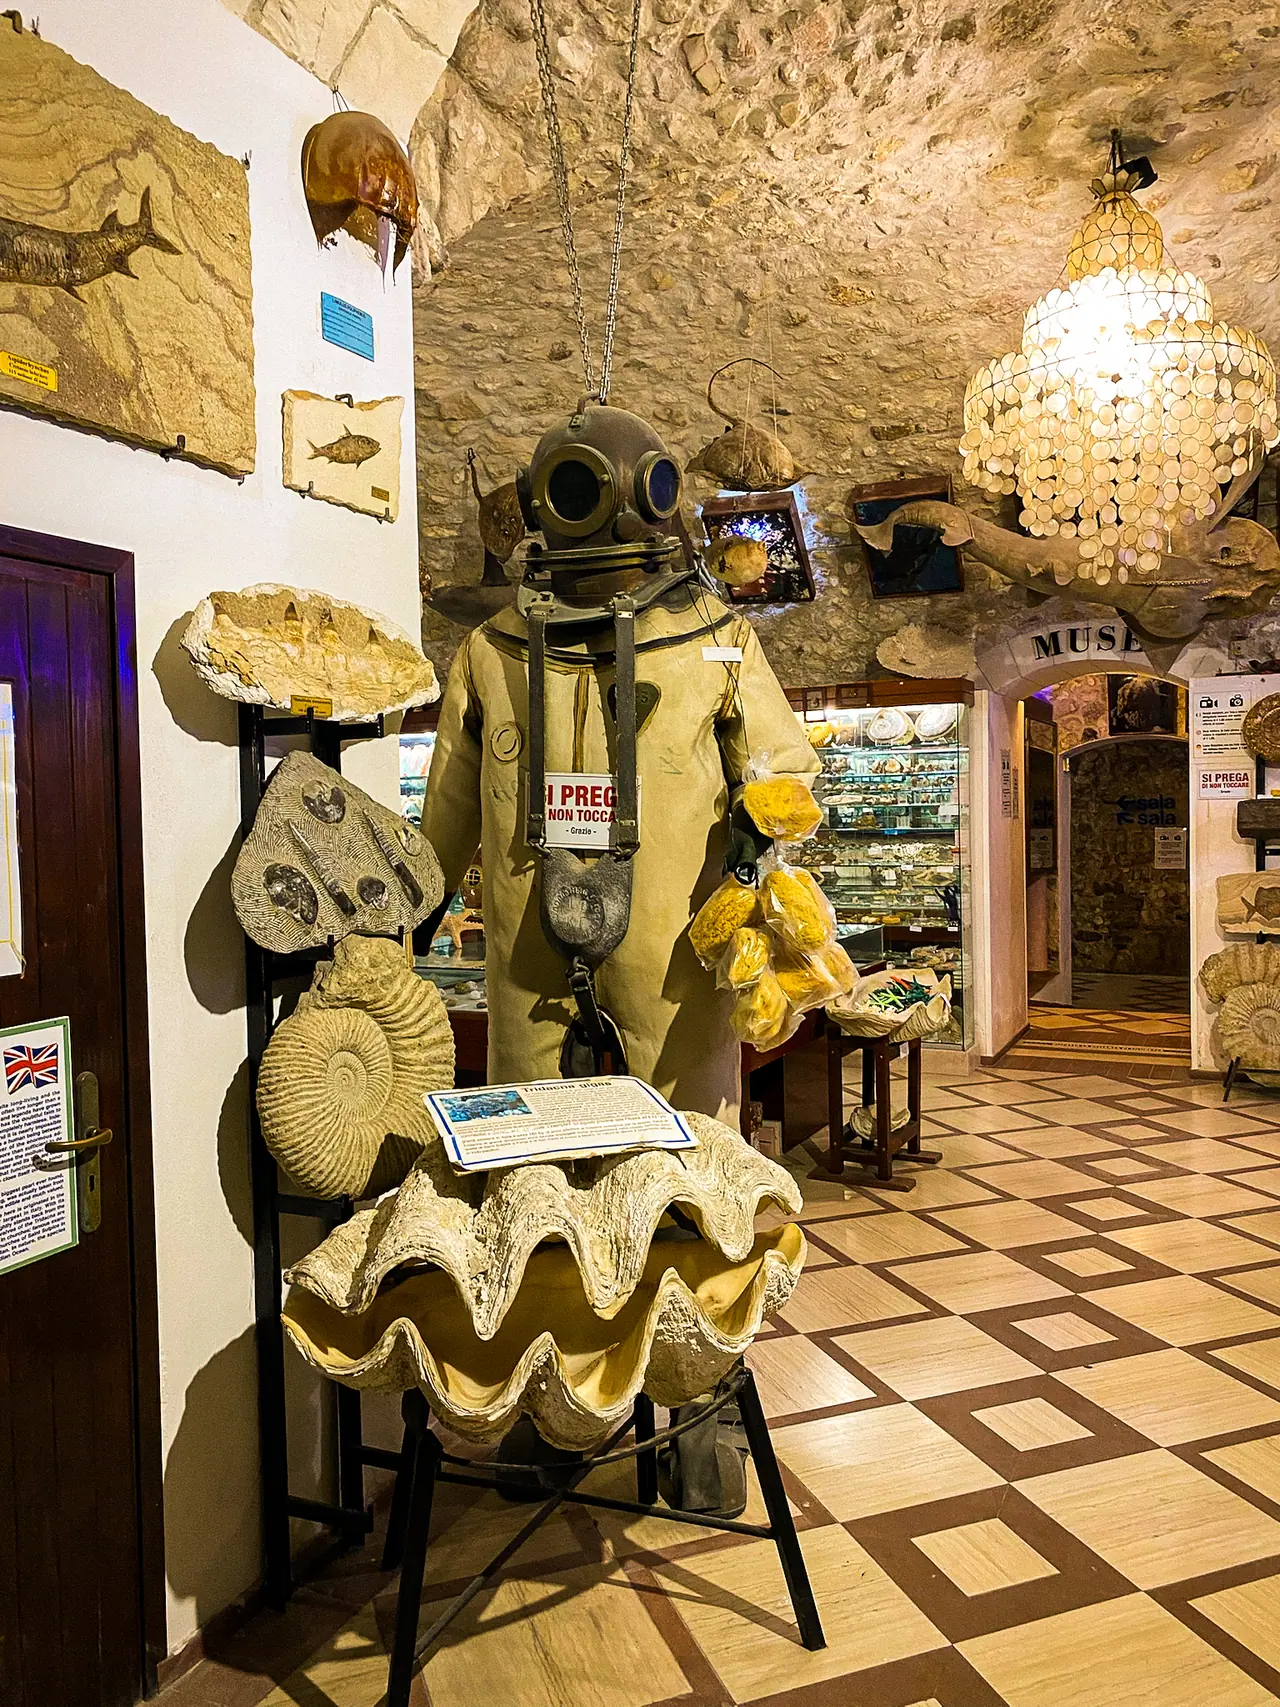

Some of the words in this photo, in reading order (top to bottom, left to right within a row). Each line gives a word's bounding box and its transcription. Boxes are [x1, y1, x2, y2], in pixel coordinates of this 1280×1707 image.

[1202, 773, 1212, 782] SI
[1215, 773, 1249, 782] PREGA
[561, 785, 618, 808] PREG
[1137, 793, 1176, 809] sala
[548, 809, 573, 821] NON
[577, 809, 617, 823] TOCCA
[1137, 810, 1176, 825] sala
[570, 826, 592, 835] Grazie
[11, 1096, 38, 1106] long-living
[12, 1110, 31, 1118] legends
[22, 1113, 42, 1121] doubtful
[36, 1120, 61, 1129] impossible
[27, 1134, 52, 1144] enormous
[1, 1187, 20, 1196] biggest
[19, 1188, 37, 1197] actually
[24, 1198, 48, 1209] originated
[3, 1213, 21, 1222] largest
[14, 1217, 30, 1225] stands
[35, 1214, 55, 1223] Tridacna
[33, 1222, 50, 1230] famous
[28, 1230, 40, 1238] Saint
[42, 1224, 59, 1232] Sulpice
[47, 1228, 65, 1237] species
